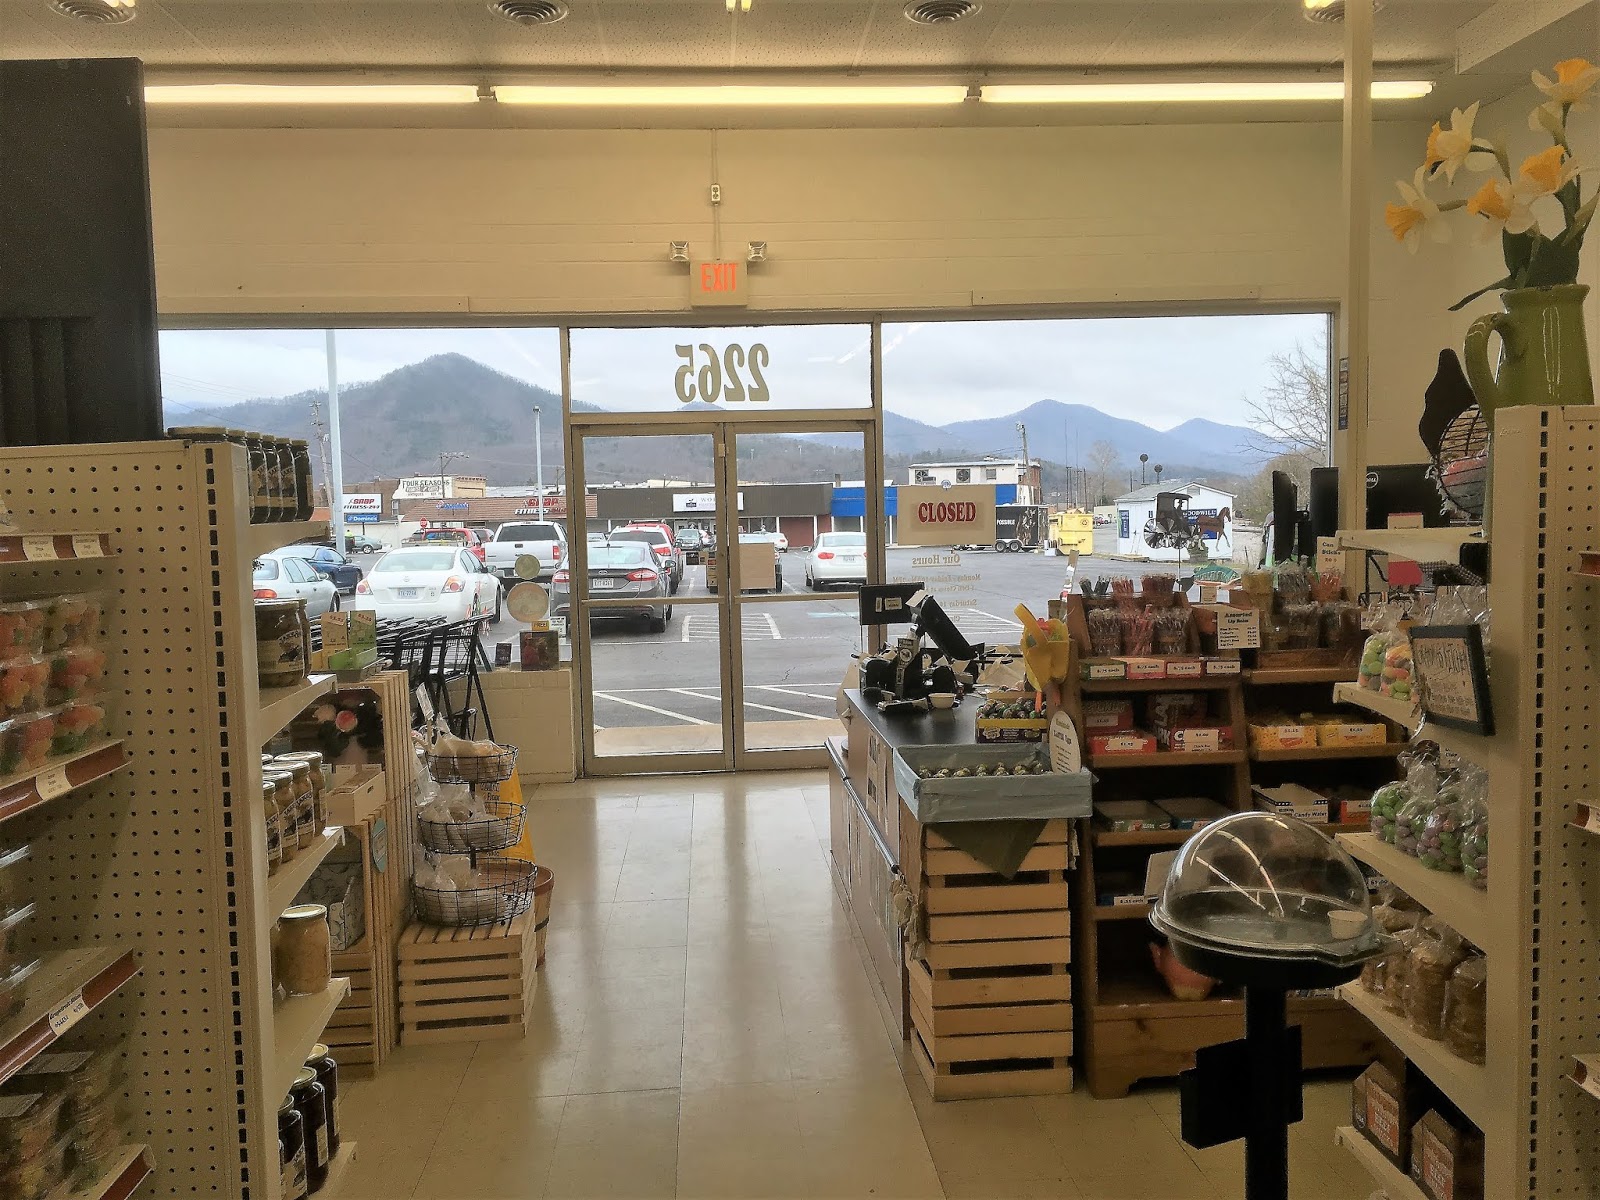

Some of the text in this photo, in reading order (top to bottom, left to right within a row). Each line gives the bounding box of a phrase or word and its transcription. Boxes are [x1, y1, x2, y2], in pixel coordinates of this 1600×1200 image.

[700, 263, 738, 292] EXIT
[402, 480, 419, 489] FOUR
[918, 501, 977, 523] CLOSED
